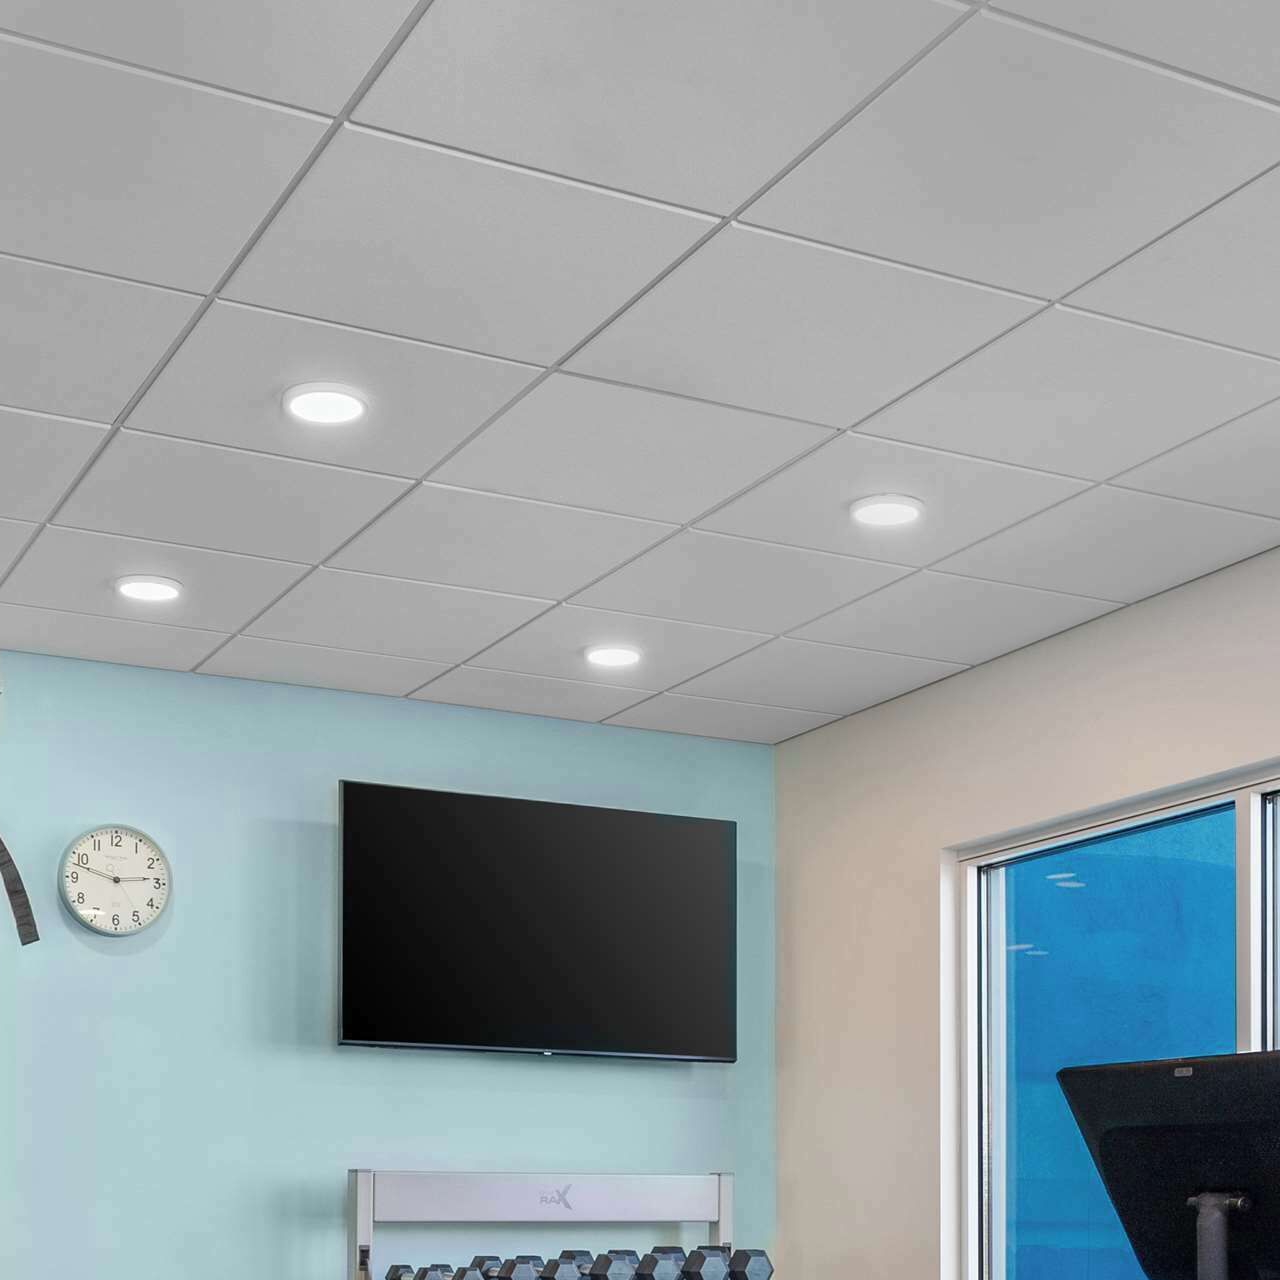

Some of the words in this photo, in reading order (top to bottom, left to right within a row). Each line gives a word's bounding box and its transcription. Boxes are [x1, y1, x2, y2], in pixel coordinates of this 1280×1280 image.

[93, 839, 101, 851] 11
[111, 835, 122, 847] 12
[77, 853, 88, 865] 10
[147, 858, 155, 869] 2
[71, 872, 78, 883] 9
[153, 878, 161, 889] 3
[77, 892, 85, 904] 8
[146, 898, 154, 909] 4
[112, 914, 120, 926] 6
[132, 911, 140, 923] 5
